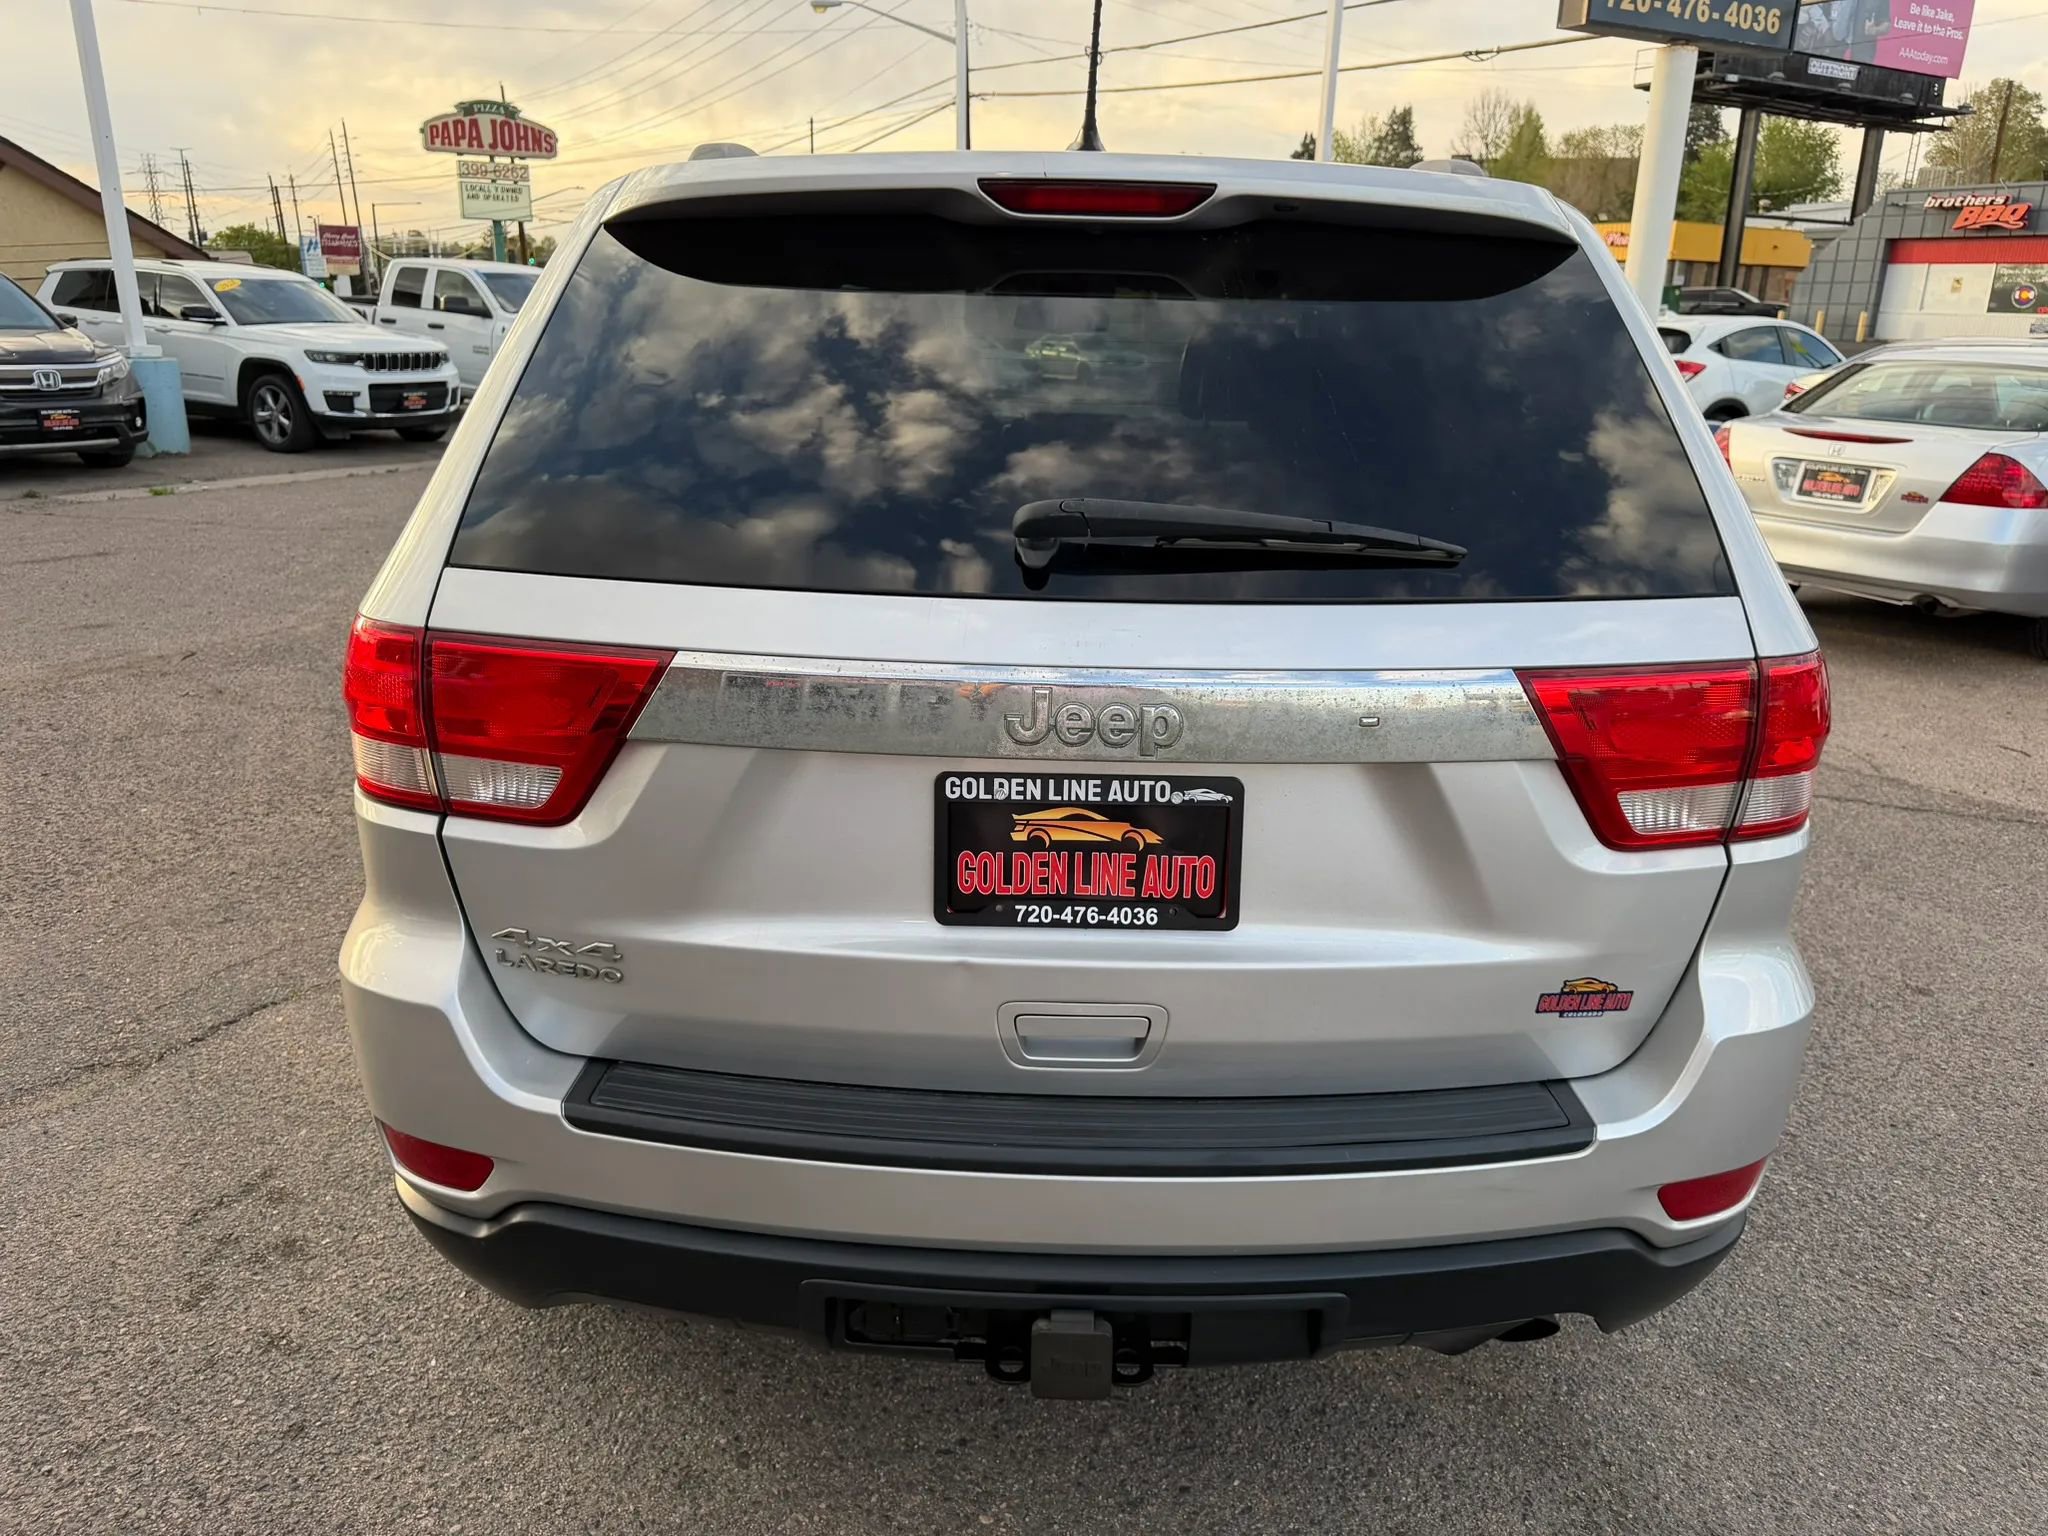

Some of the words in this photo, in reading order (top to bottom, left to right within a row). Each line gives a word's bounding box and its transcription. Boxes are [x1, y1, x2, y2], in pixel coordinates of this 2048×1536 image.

[1910, 2, 1920, 15] Be
[1921, 4, 1935, 18] like
[1936, 8, 1955, 23] Jake,
[1894, 16, 1916, 31] Leave
[1917, 19, 1923, 32] it
[1924, 23, 1932, 34] to
[1933, 23, 1945, 37] the
[1899, 47, 1948, 65] AAAtoday.com
[473, 103, 505, 115] PIZZA
[429, 118, 484, 149] PAPA
[489, 119, 554, 153] JOHNS
[1924, 195, 2009, 208] brothers
[1952, 203, 2030, 229] BBQ
[1004, 687, 1184, 760] Jeep
[945, 777, 1039, 801] GOLDEN
[1048, 778, 1101, 802] LINE
[1108, 780, 1171, 803] AUTO
[957, 851, 1068, 896] GOLDEN
[1074, 852, 1136, 897] LINE
[1142, 855, 1216, 899] AUTO
[1015, 905, 1158, 926] 720-476-4036
[495, 948, 624, 983] LAREDO
[1538, 994, 1581, 1011] GOLDEN
[1579, 993, 1604, 1010] LINE
[1603, 993, 1632, 1010] AUTO
